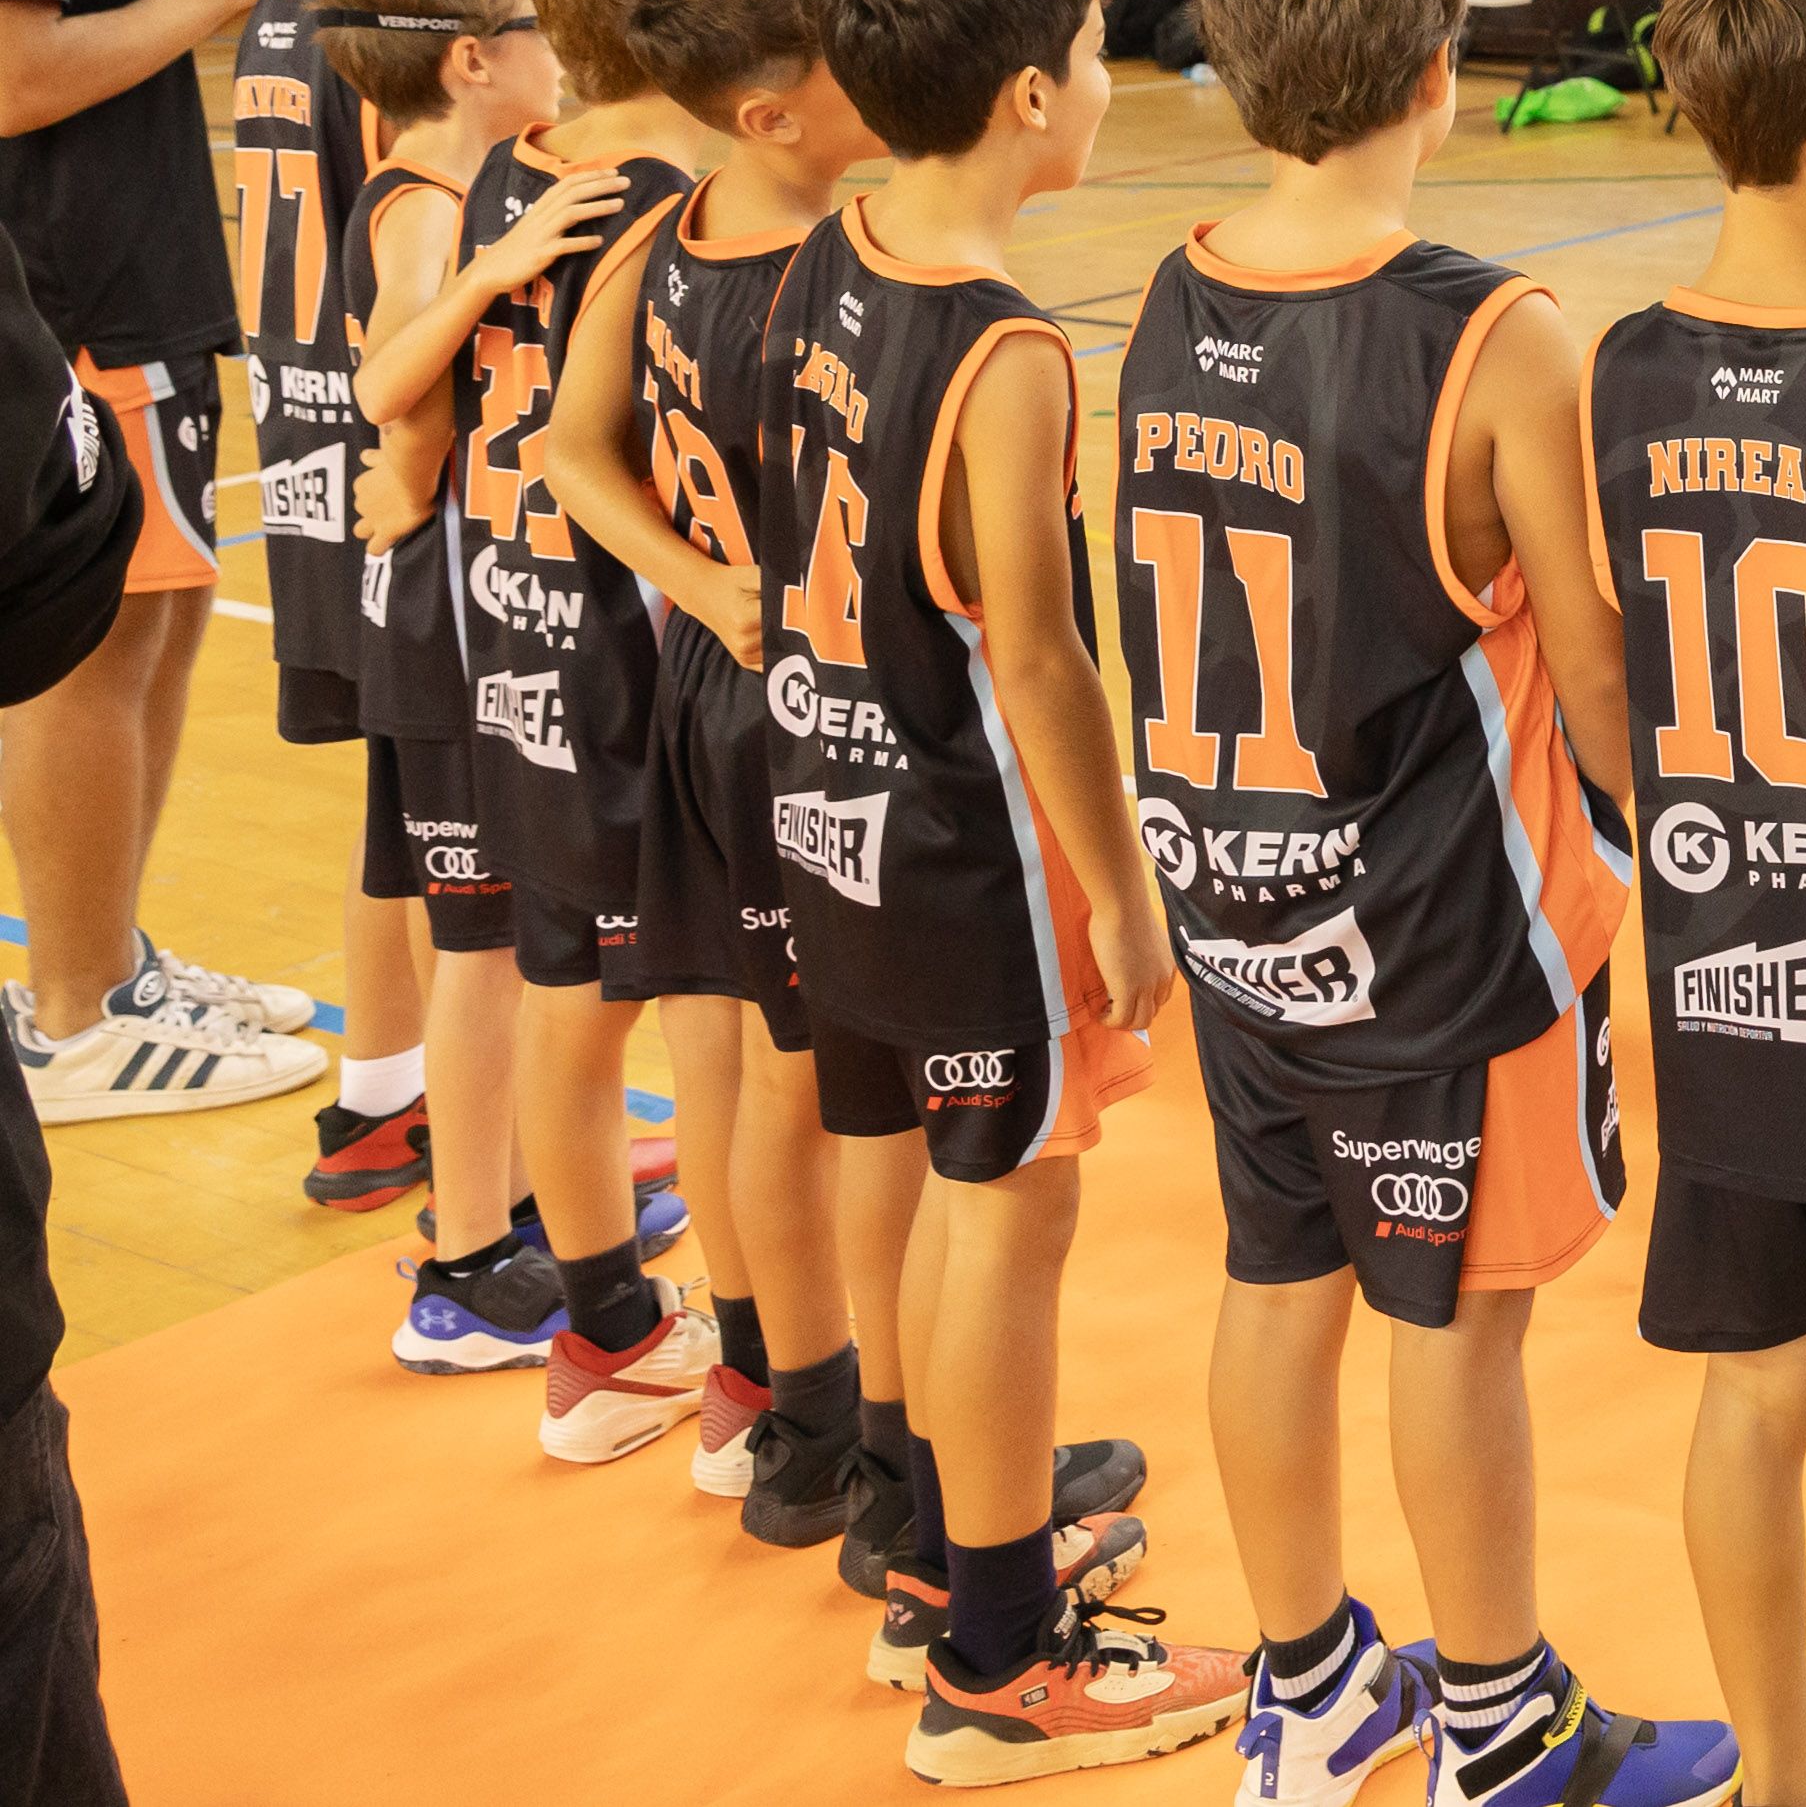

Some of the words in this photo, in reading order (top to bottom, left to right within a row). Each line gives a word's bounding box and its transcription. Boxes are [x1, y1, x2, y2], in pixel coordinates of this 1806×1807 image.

[234, 147, 328, 344] 77
[1217, 338, 1264, 362] MARC
[279, 365, 352, 405] KERN
[1217, 363, 1261, 384] MART
[1738, 367, 1785, 384] MARC
[1736, 385, 1780, 404] MART
[464, 322, 577, 561] 22
[1133, 411, 1305, 505] PEDRO
[1132, 505, 1328, 799] 11
[810, 691, 897, 745] ER
[820, 740, 909, 770] ARMA
[1202, 821, 1361, 878] KERN
[1212, 858, 1366, 905] PHARMA
[598, 934, 625, 946] udi
[1331, 1129, 1482, 1170] Superwage
[1395, 1222, 1425, 1240] Audi
[1427, 1224, 1469, 1247] Spor
